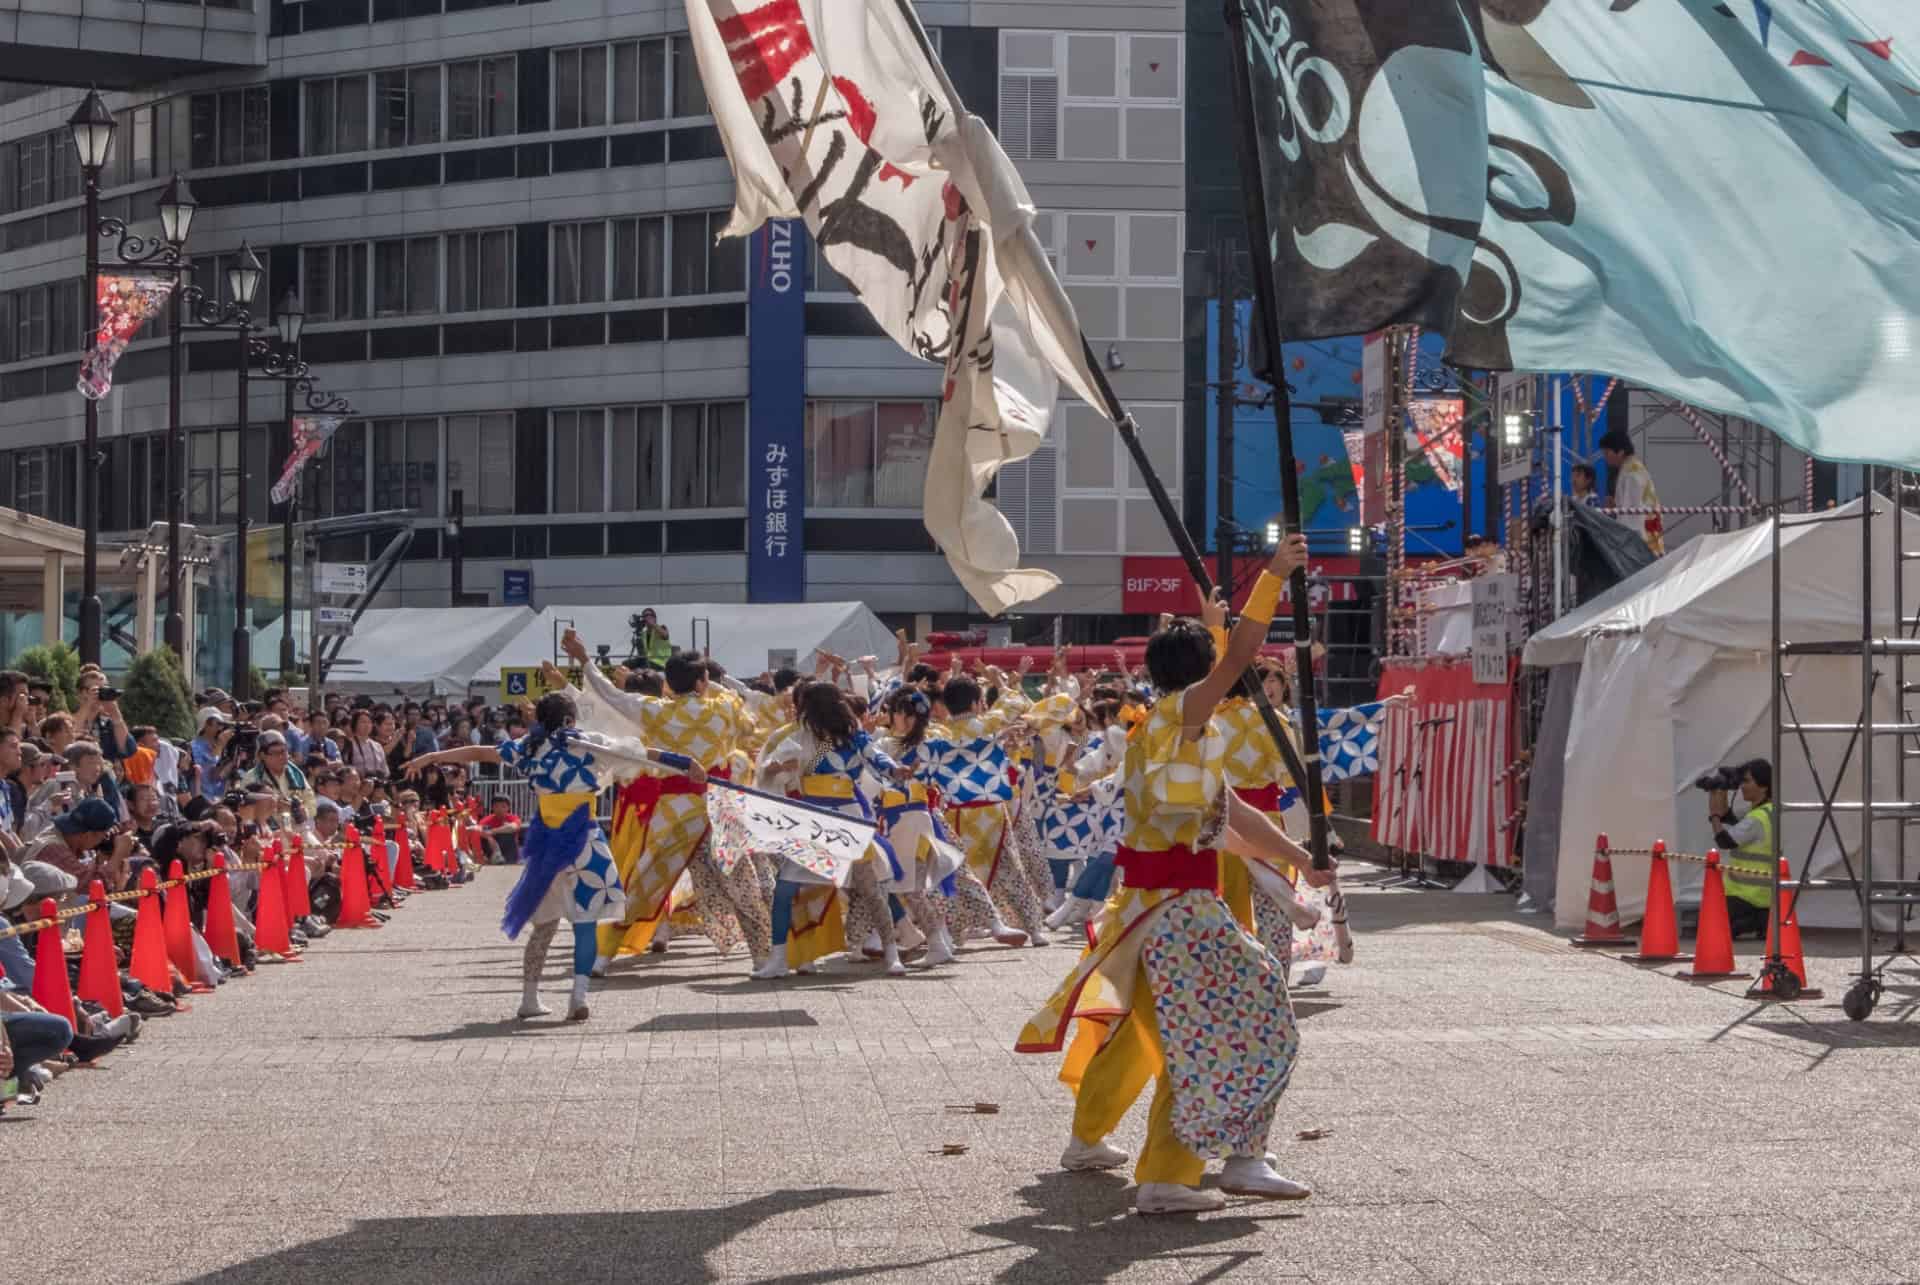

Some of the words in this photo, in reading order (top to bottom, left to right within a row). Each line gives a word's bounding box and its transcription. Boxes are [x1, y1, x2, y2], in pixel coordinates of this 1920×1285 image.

[765, 443, 789, 558] みずほ銀行
